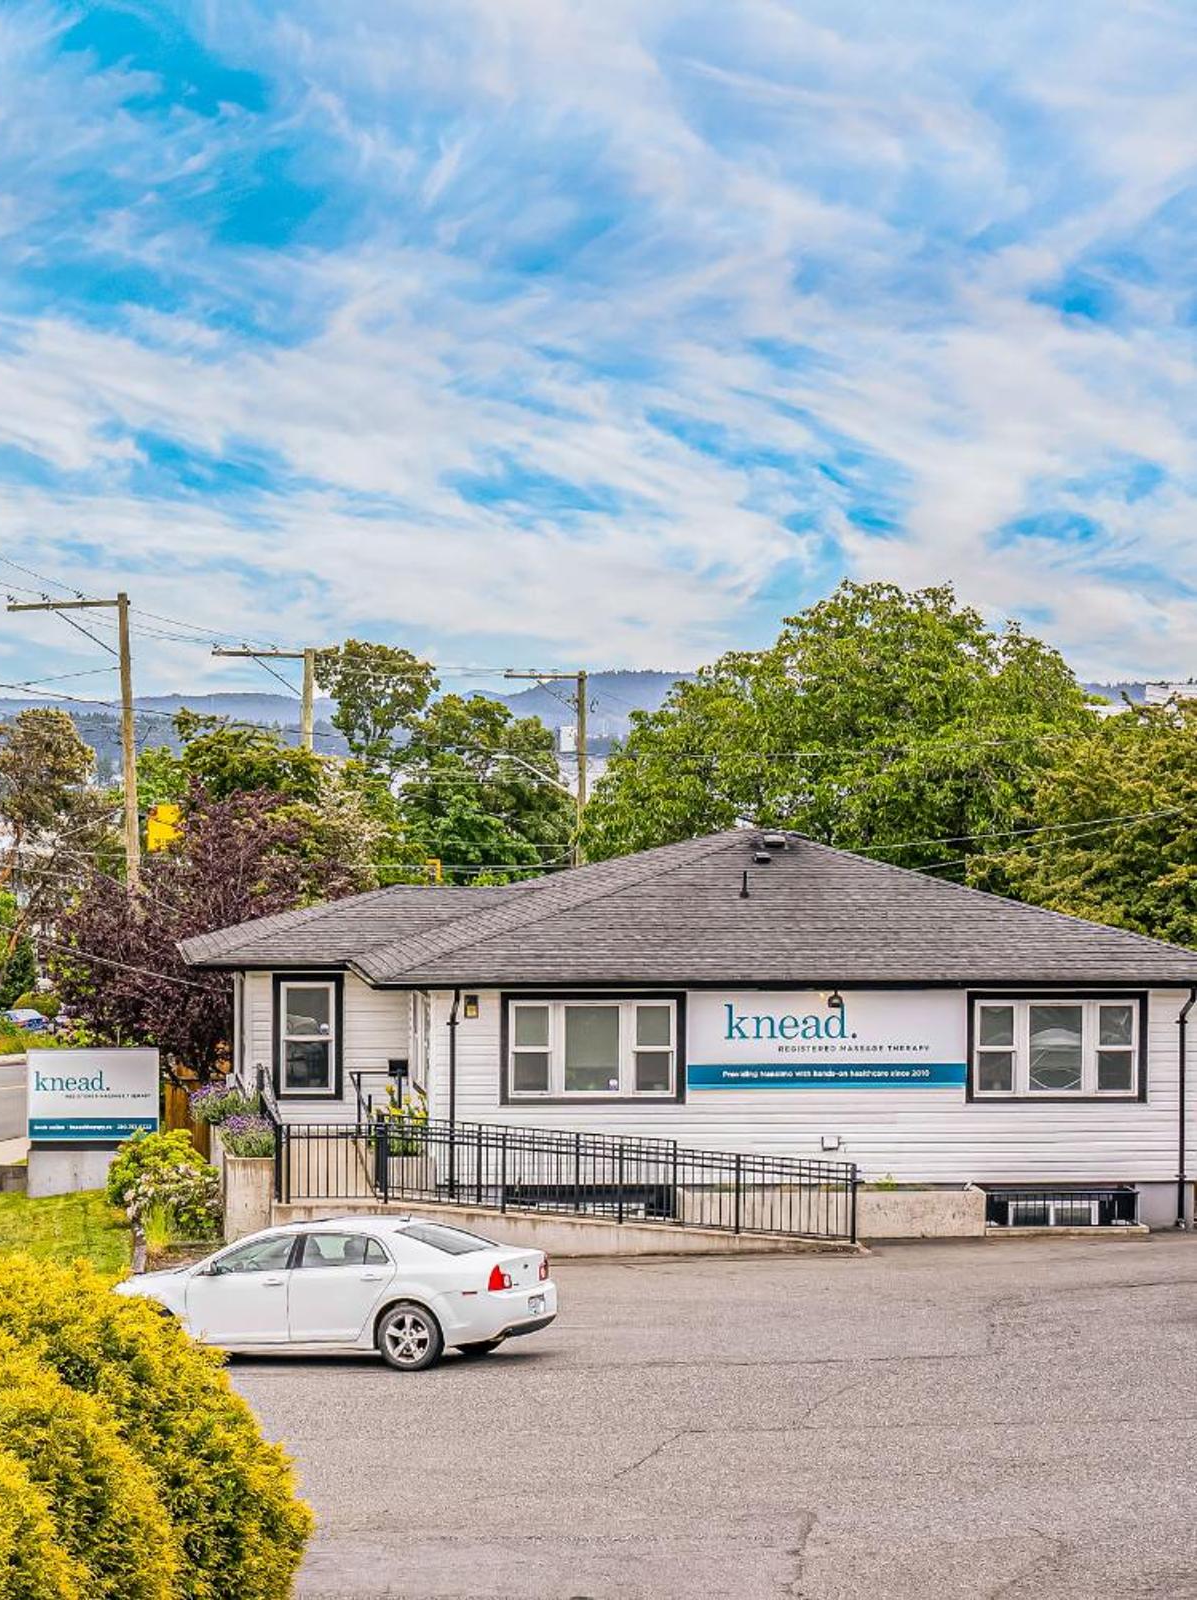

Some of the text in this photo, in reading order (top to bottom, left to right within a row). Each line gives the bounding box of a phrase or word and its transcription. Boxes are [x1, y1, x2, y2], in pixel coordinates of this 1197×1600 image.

[724, 1004, 857, 1039] knead.
[35, 1071, 110, 1091] knead.
[795, 1070, 811, 1078] with
[813, 1070, 848, 1078] hands-on
[850, 1070, 889, 1078] healthcare
[890, 1070, 910, 1078] since
